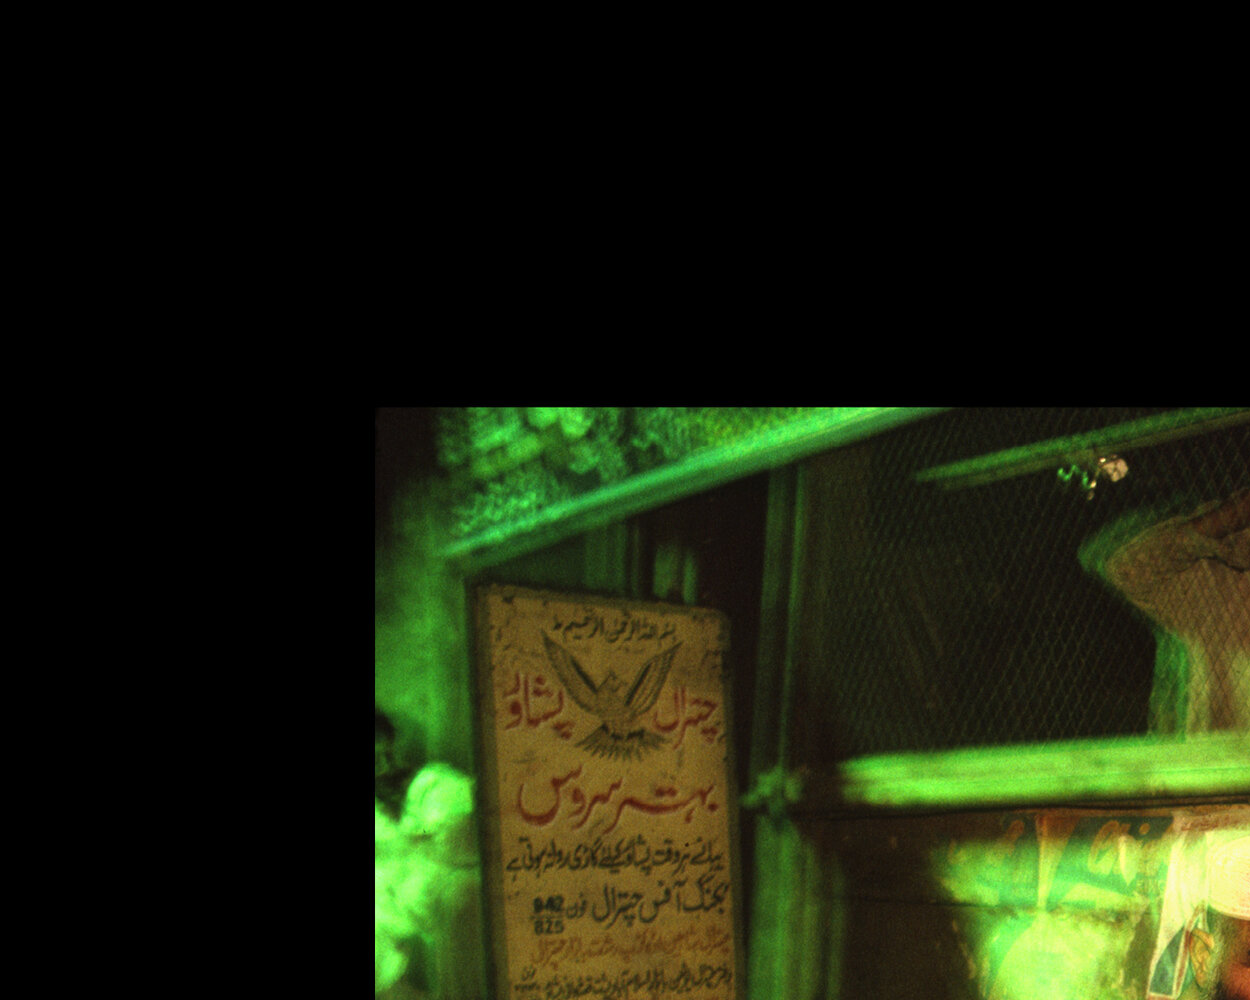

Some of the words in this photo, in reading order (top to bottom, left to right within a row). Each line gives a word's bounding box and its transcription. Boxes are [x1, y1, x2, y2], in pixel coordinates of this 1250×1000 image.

[503, 672, 575, 740] پشاور
[654, 685, 718, 750] چترال
[517, 764, 623, 830] سروس
[591, 883, 644, 930] چترال
